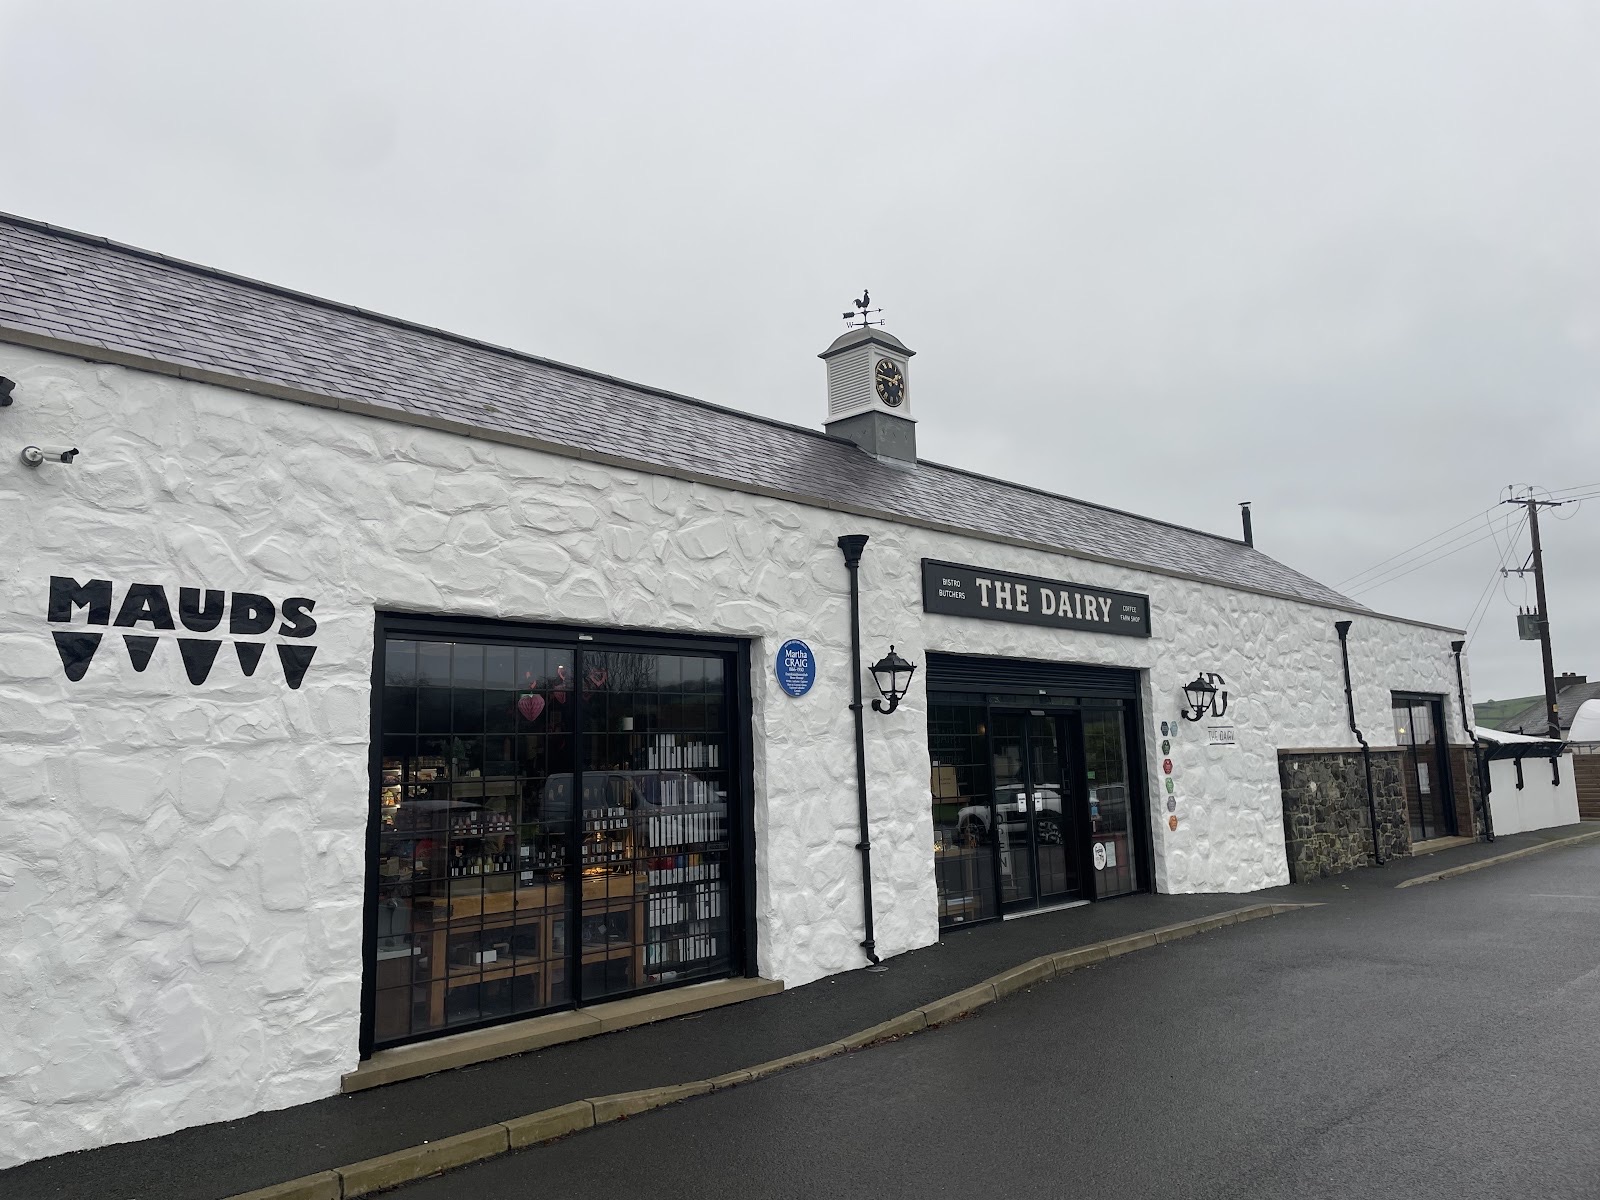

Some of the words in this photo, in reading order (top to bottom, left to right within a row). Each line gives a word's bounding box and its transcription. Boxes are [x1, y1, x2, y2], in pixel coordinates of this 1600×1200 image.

[942, 578, 961, 588] BISTRO
[938, 589, 966, 600] BUTCHERS
[975, 577, 1030, 613] THE
[1040, 588, 1112, 623] DAIRY
[47, 575, 318, 639] MAUDS
[786, 650, 807, 658] Martha
[785, 658, 808, 667] CRAIG
